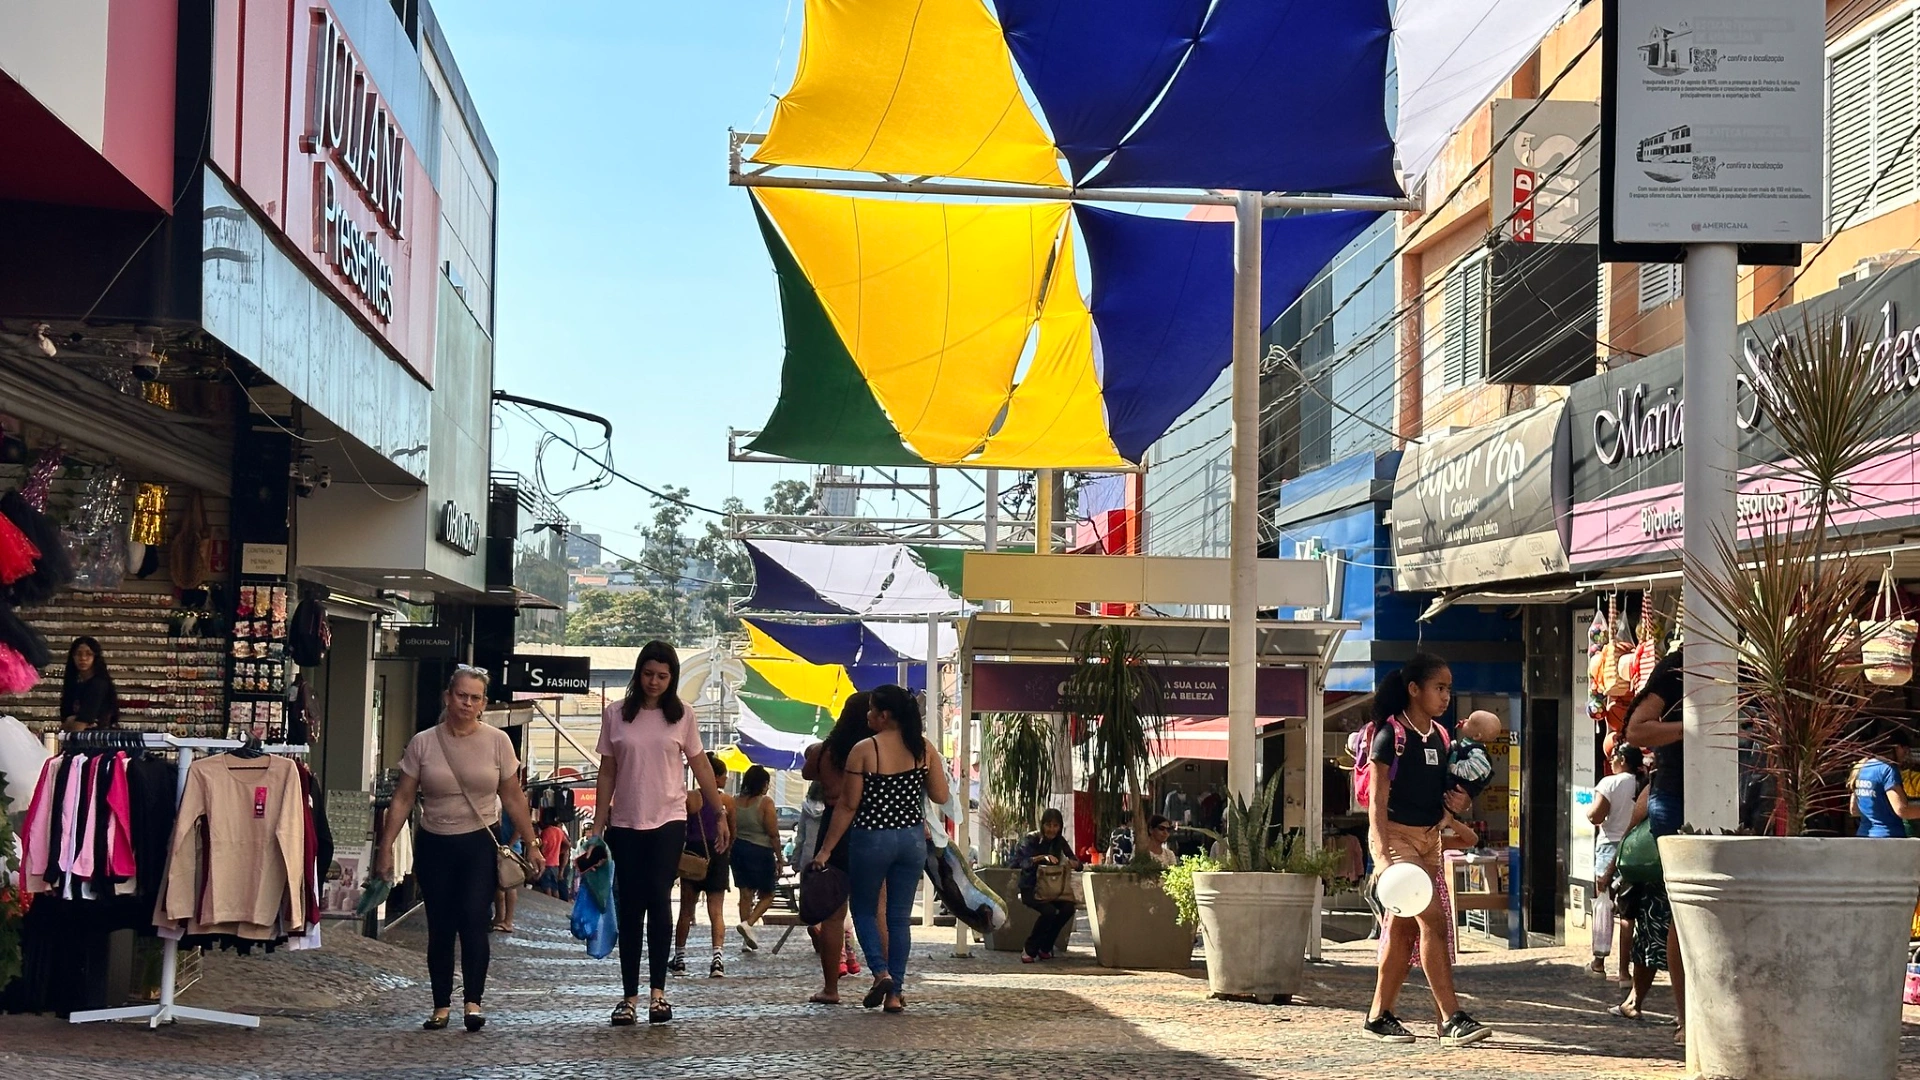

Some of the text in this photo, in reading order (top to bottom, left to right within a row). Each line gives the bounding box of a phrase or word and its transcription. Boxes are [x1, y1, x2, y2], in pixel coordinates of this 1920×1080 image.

[1727, 54, 1748, 62] confira
[1753, 54, 1785, 62] localização
[309, 9, 405, 241] JULIANA
[1726, 161, 1747, 170] confira
[1752, 161, 1784, 170] localização
[1702, 222, 1749, 230] AMERICANA
[317, 161, 394, 325] Presentes
[1594, 383, 1684, 465] Maria
[1416, 431, 1525, 521] Super Pop
[1451, 494, 1479, 520] Calçados
[1453, 526, 1462, 545] loja
[1469, 523, 1483, 542] preço
[1483, 519, 1498, 537] único
[547, 678, 588, 689] FASHION
[1173, 681, 1192, 689] SUA
[1194, 681, 1217, 690] LOJA
[1179, 692, 1214, 701] BELEZA
